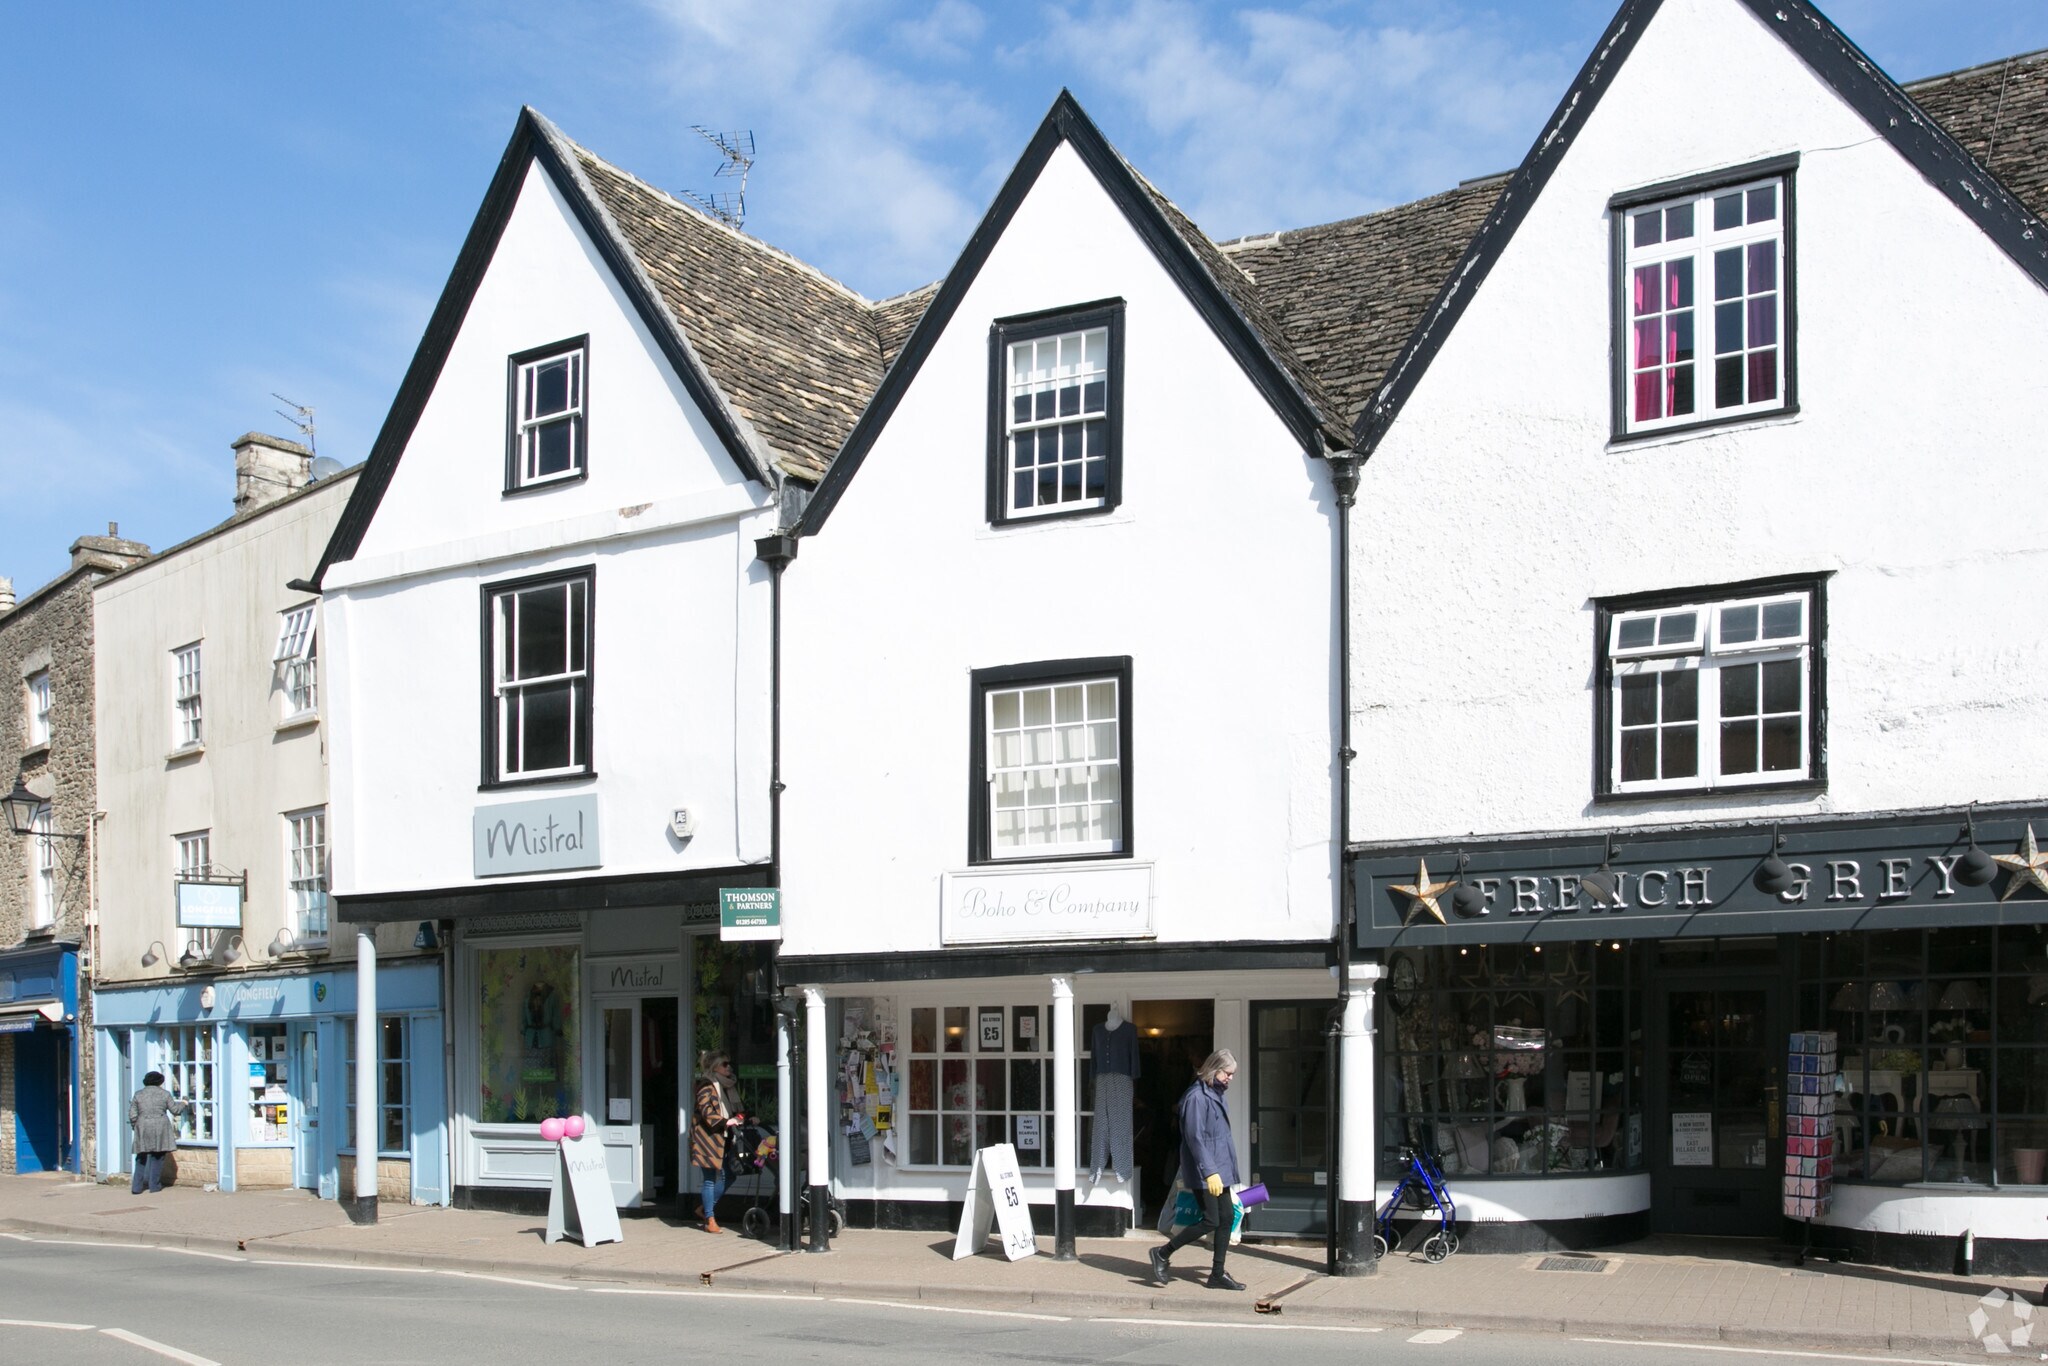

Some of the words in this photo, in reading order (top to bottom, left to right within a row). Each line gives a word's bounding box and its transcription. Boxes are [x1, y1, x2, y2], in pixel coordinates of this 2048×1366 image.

[487, 809, 583, 859] Mistral
[1472, 866, 1713, 914] FRENCH
[1777, 854, 1962, 901] GREY
[725, 893, 775, 902] THOMSON
[736, 902, 773, 910] PARTNERS
[958, 887, 1016, 918] Boho
[1024, 889, 1048, 916] &
[1048, 883, 1140, 918] Company
[182, 904, 236, 914] LONGFIELD
[611, 964, 664, 988] Mistral
[236, 986, 281, 1002] LONGFIELD
[984, 1027, 999, 1041] £5
[569, 1155, 606, 1174] Mistral
[1005, 1186, 1019, 1207] £5
